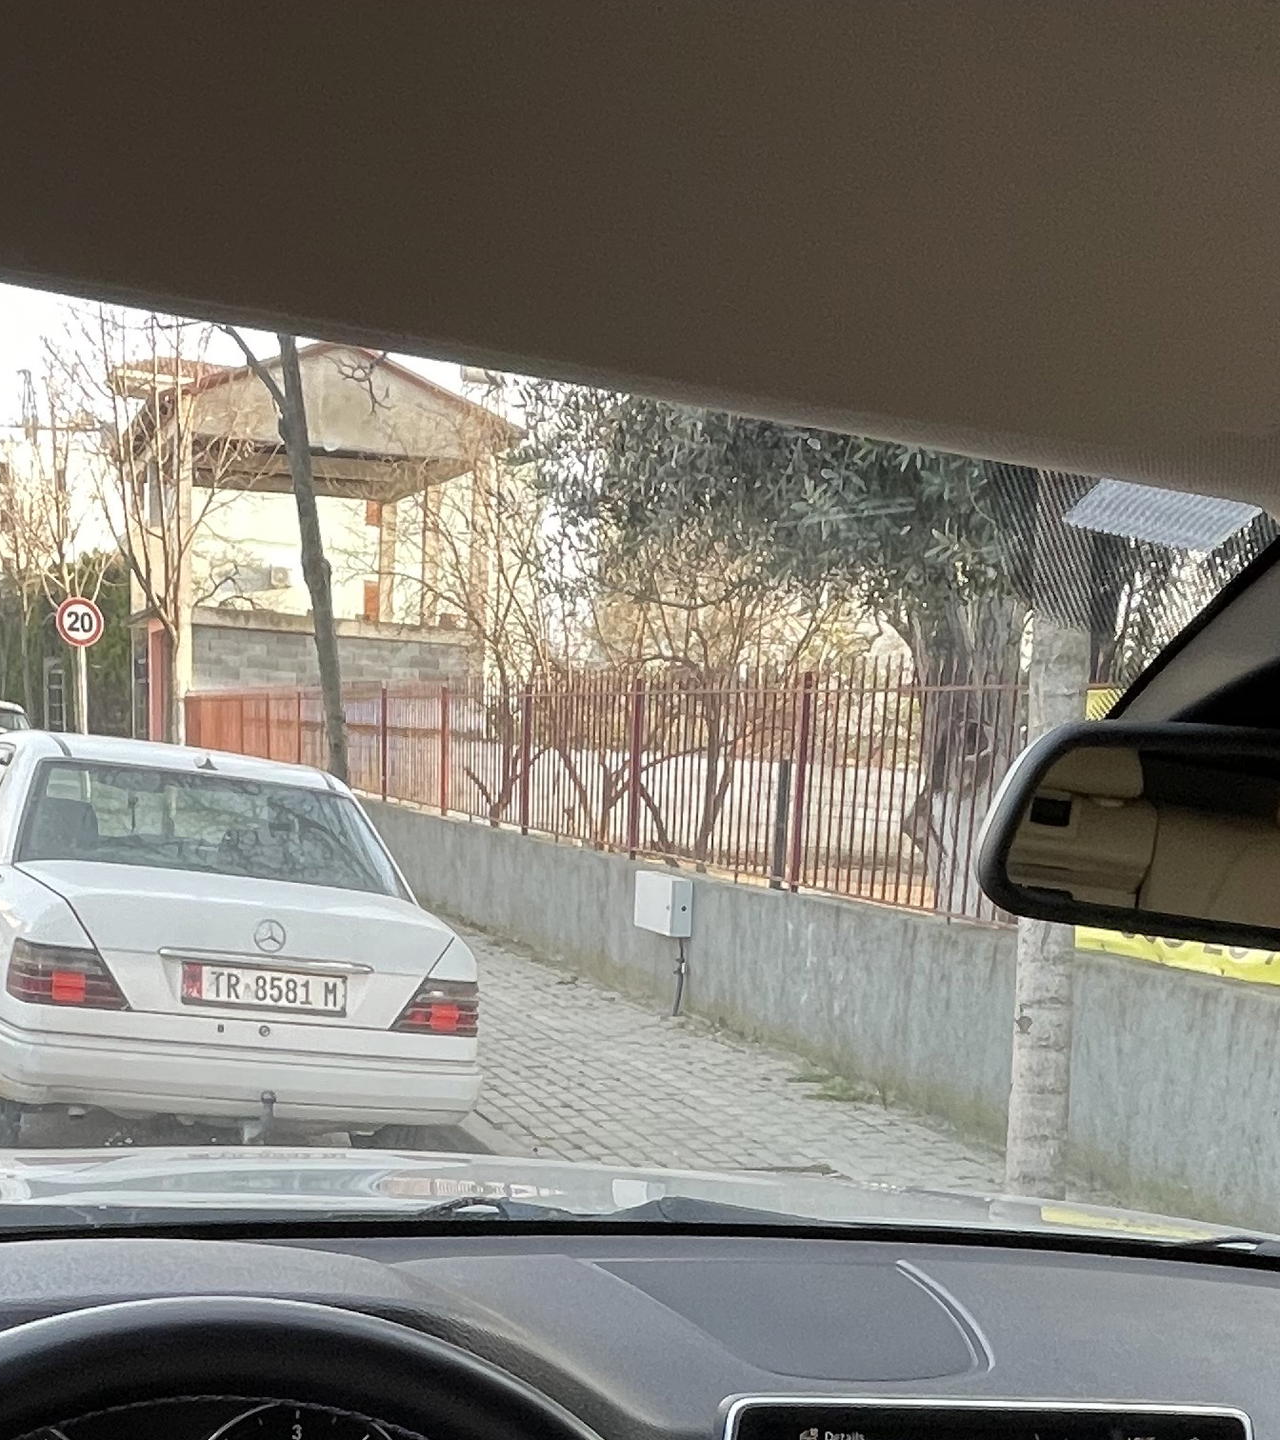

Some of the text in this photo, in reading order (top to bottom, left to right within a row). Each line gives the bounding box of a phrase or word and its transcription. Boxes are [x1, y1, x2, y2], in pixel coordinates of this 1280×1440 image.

[67, 611, 93, 633] 20
[211, 971, 337, 1007] TR 8581 M
[291, 1424, 302, 1440] 3
